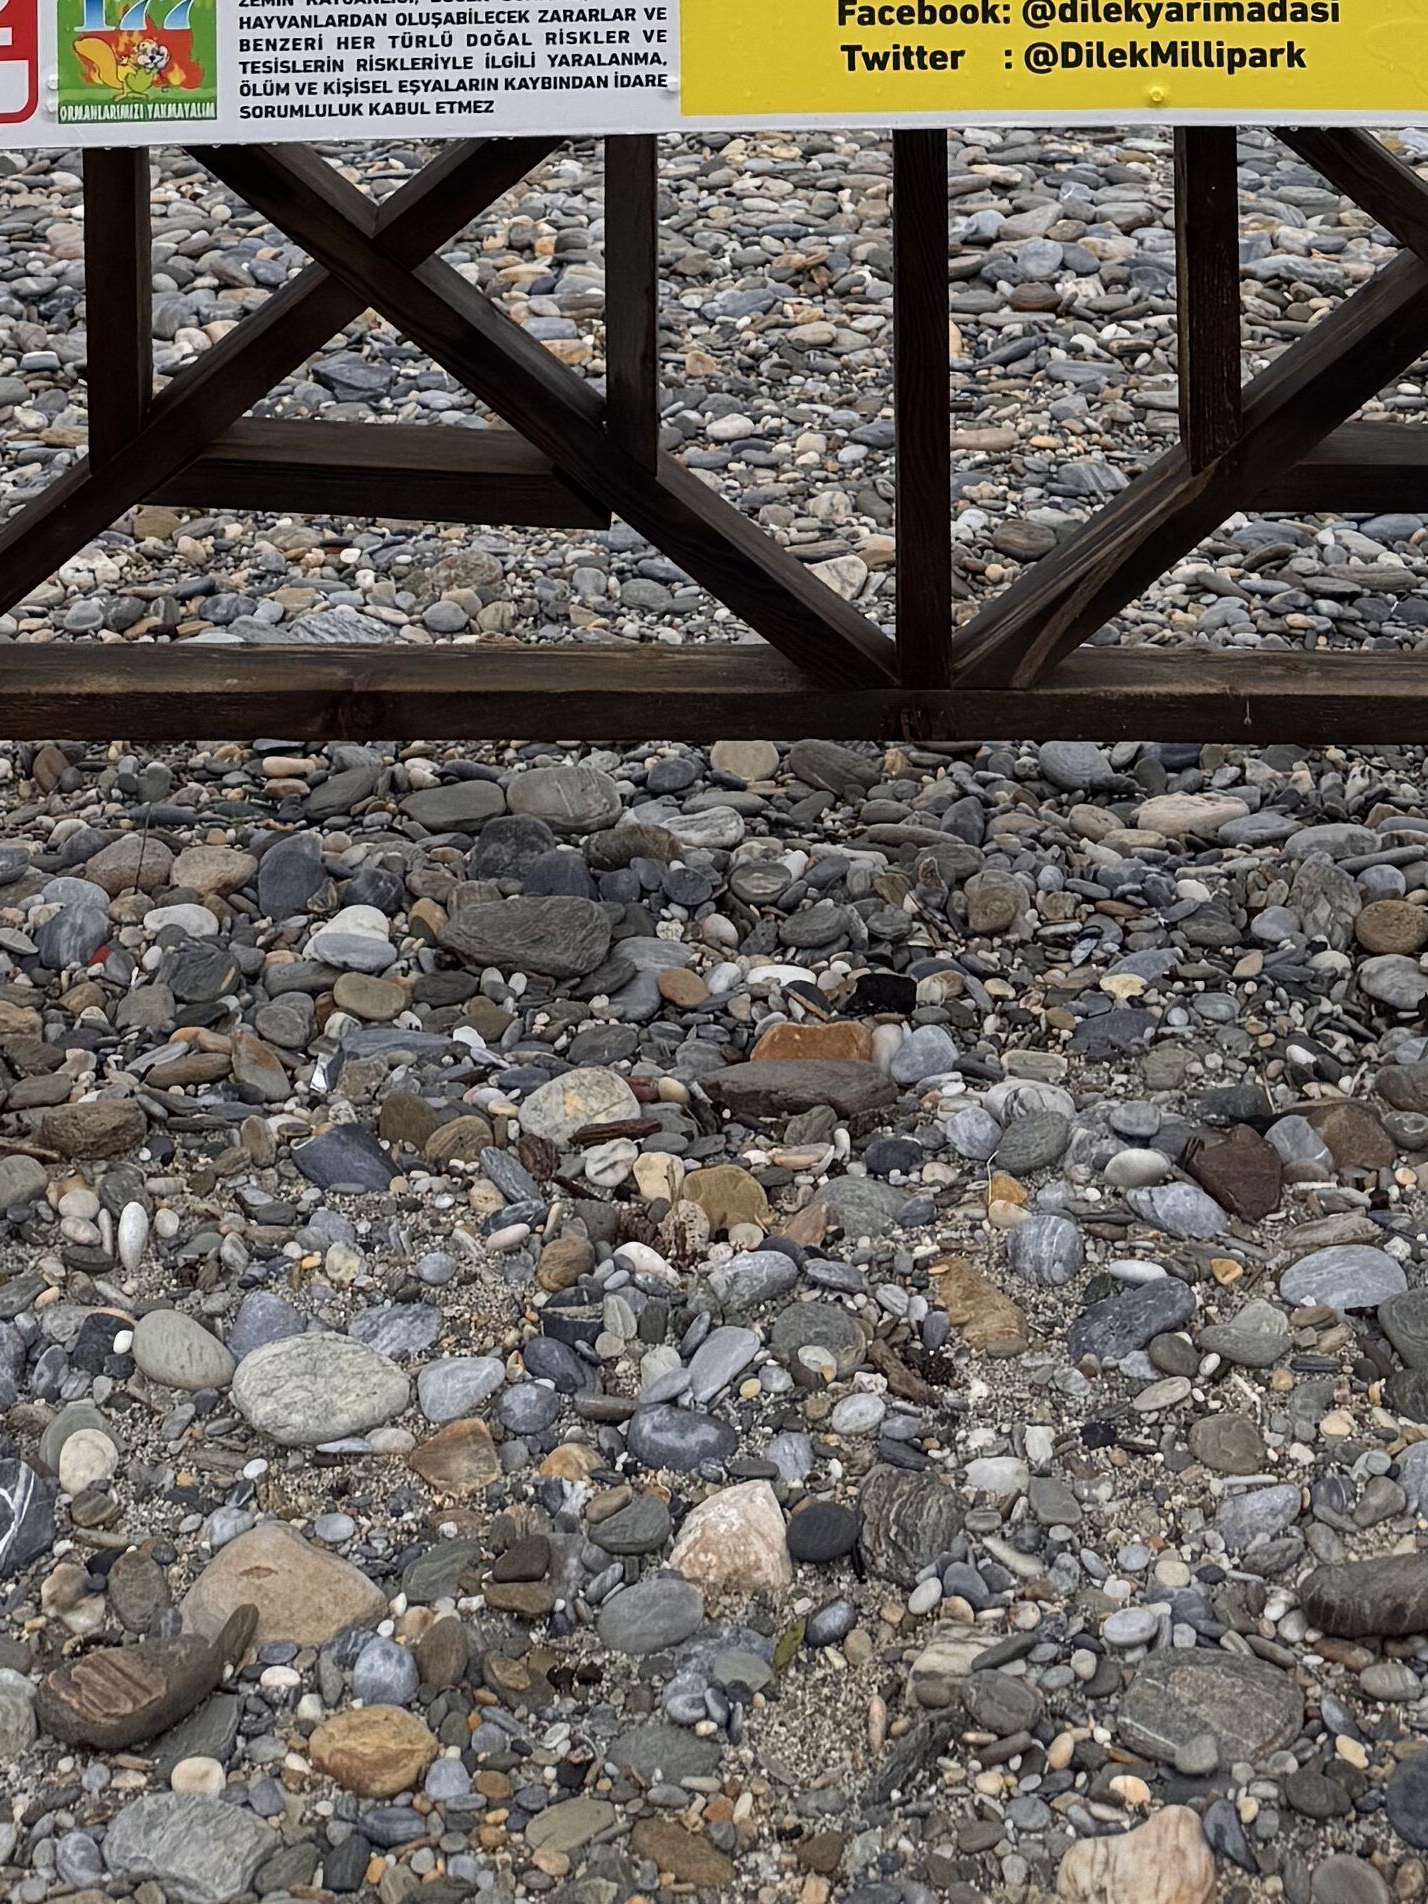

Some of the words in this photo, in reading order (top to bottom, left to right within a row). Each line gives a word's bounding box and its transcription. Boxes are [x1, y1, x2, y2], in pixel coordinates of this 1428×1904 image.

[240, 13, 387, 30] HAYVANLARDAN
[396, 8, 530, 28] OLUŞABİLECEK
[538, 8, 637, 23] ZARARLAR
[644, 6, 667, 21] VE
[840, 44, 965, 71] Twitter
[1024, 40, 1306, 75] @DilekMillipark
[239, 103, 364, 119] SORUMLULUK
[368, 102, 431, 116] KABUL
[435, 100, 494, 115] ETMEZ
